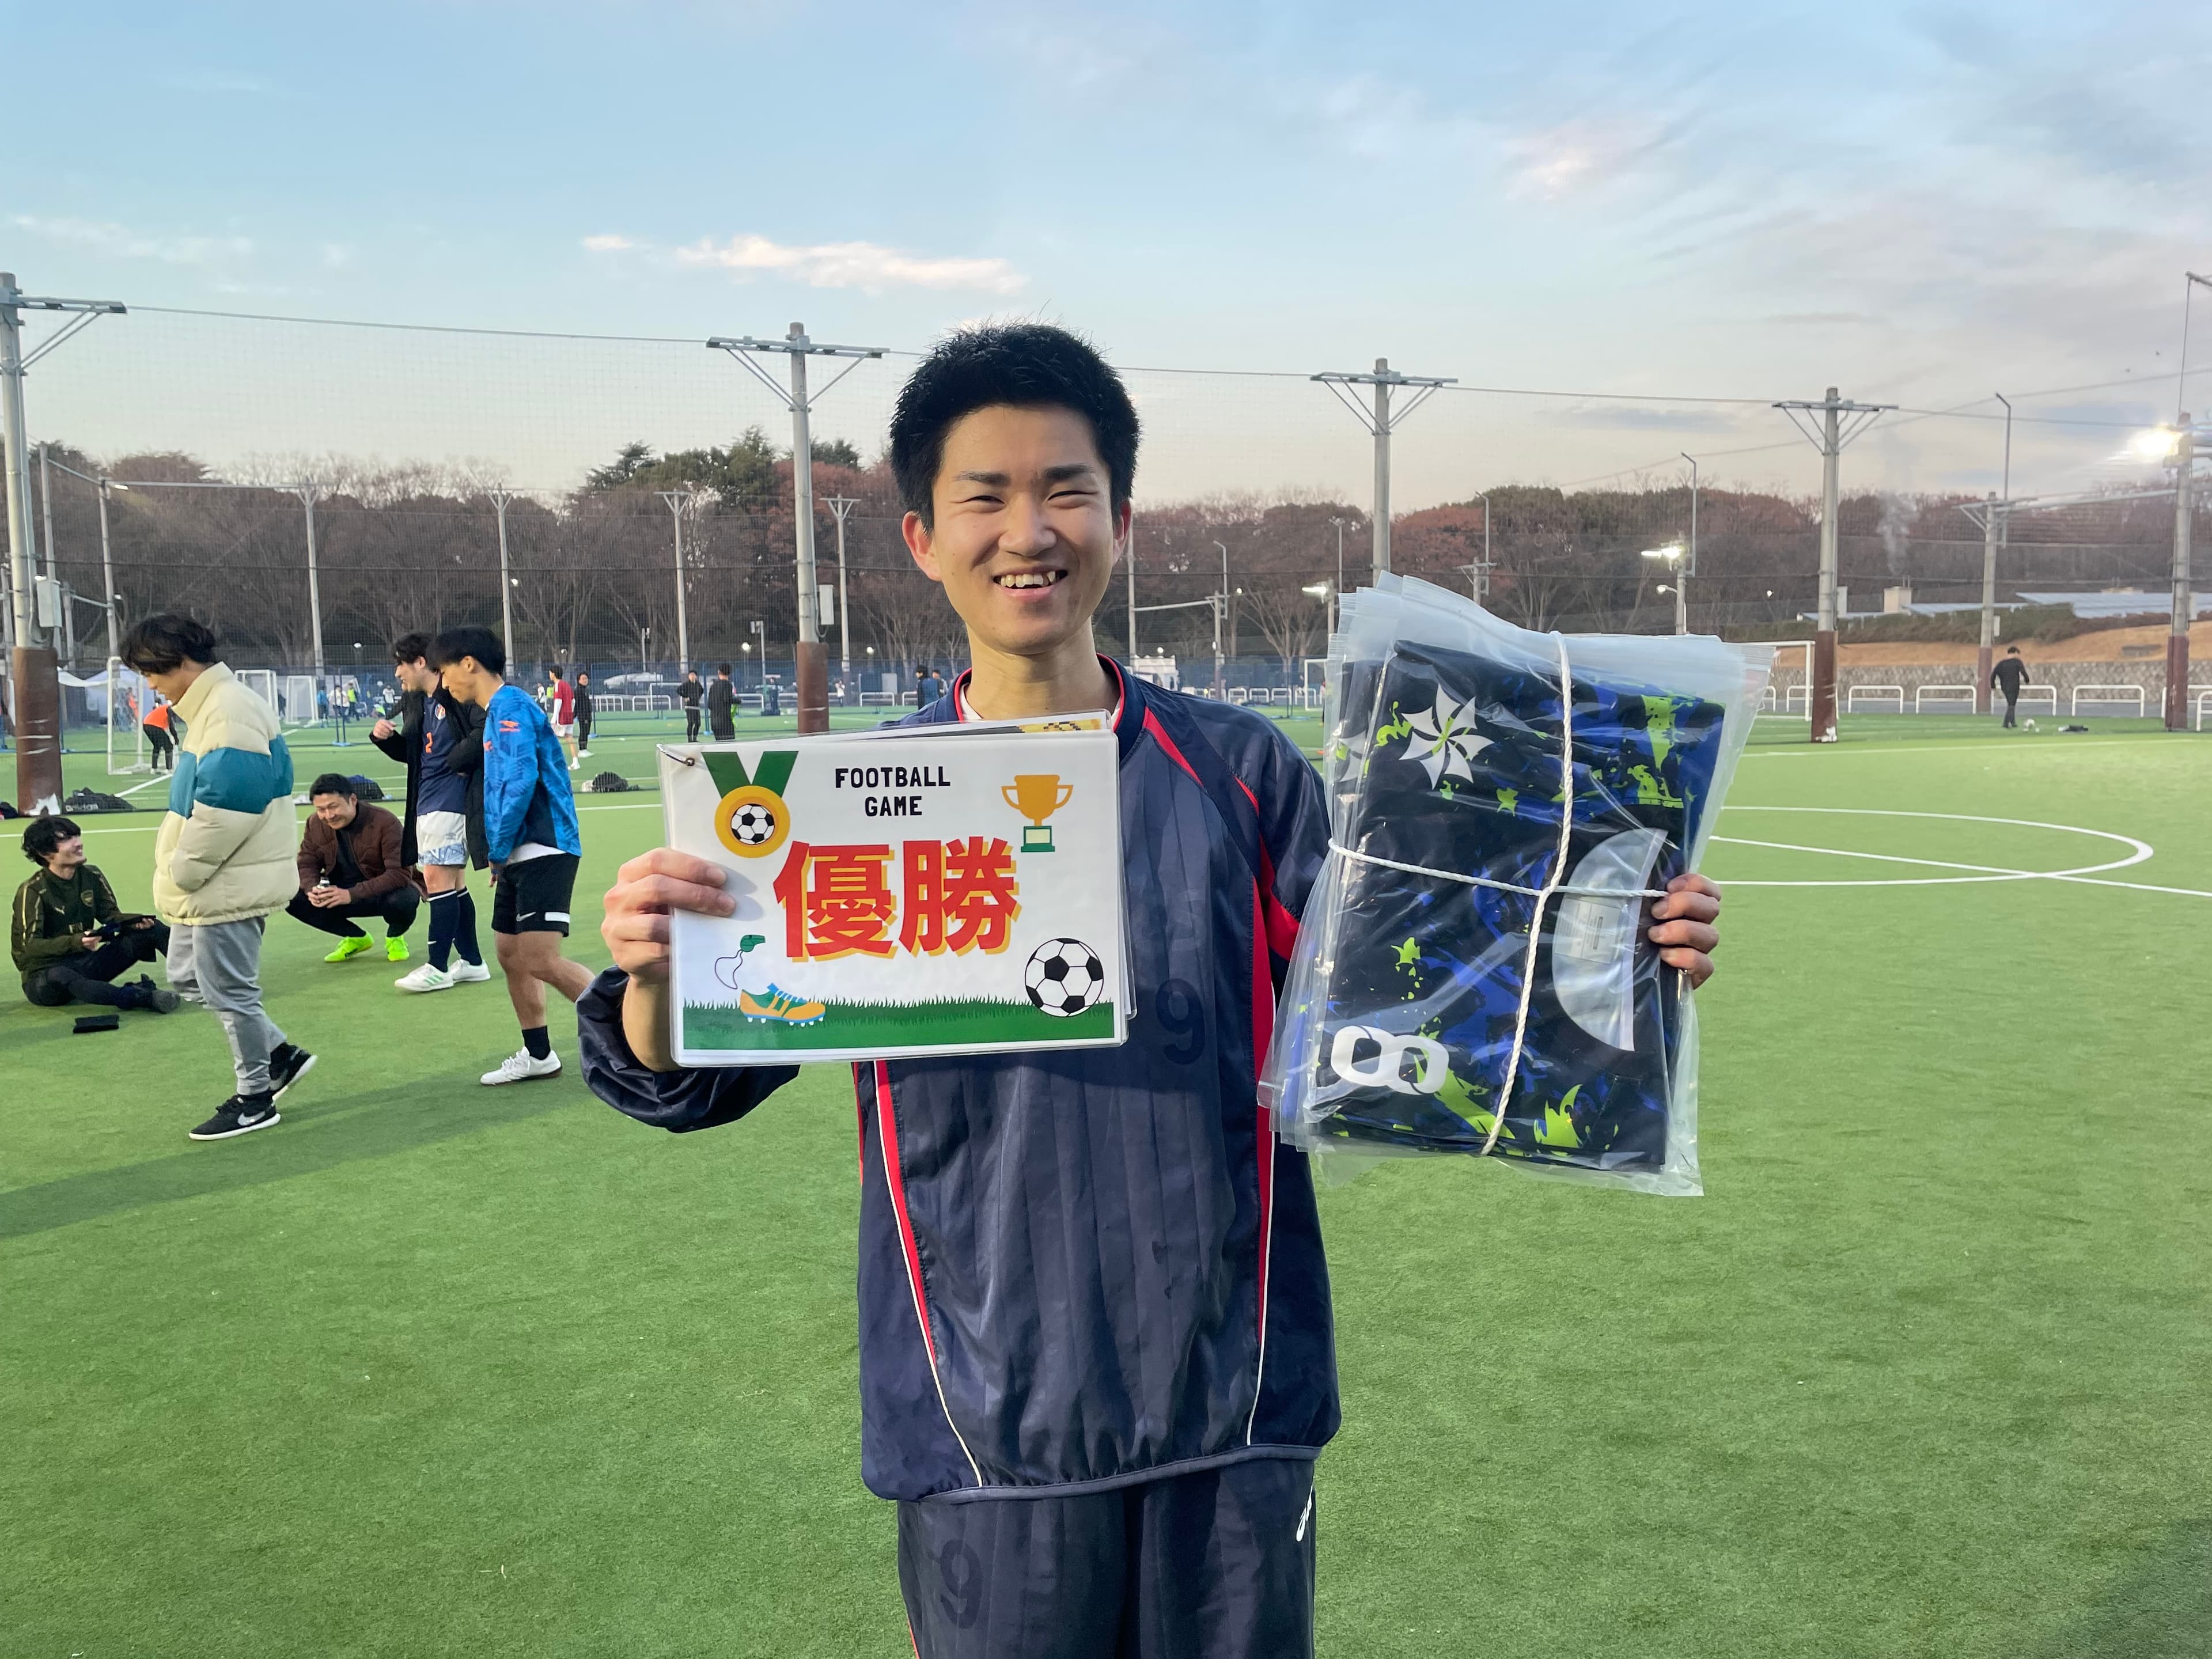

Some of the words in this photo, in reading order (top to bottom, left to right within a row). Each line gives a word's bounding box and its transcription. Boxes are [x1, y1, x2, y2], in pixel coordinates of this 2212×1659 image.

[425, 732, 433, 753] 2
[835, 766, 951, 789] FOOTBALL
[864, 796, 923, 817] GAME
[773, 836, 1020, 961] 優勝
[1155, 977, 1206, 1065] 9
[1331, 1025, 1449, 1095] 8
[940, 1539, 983, 1630] 9
